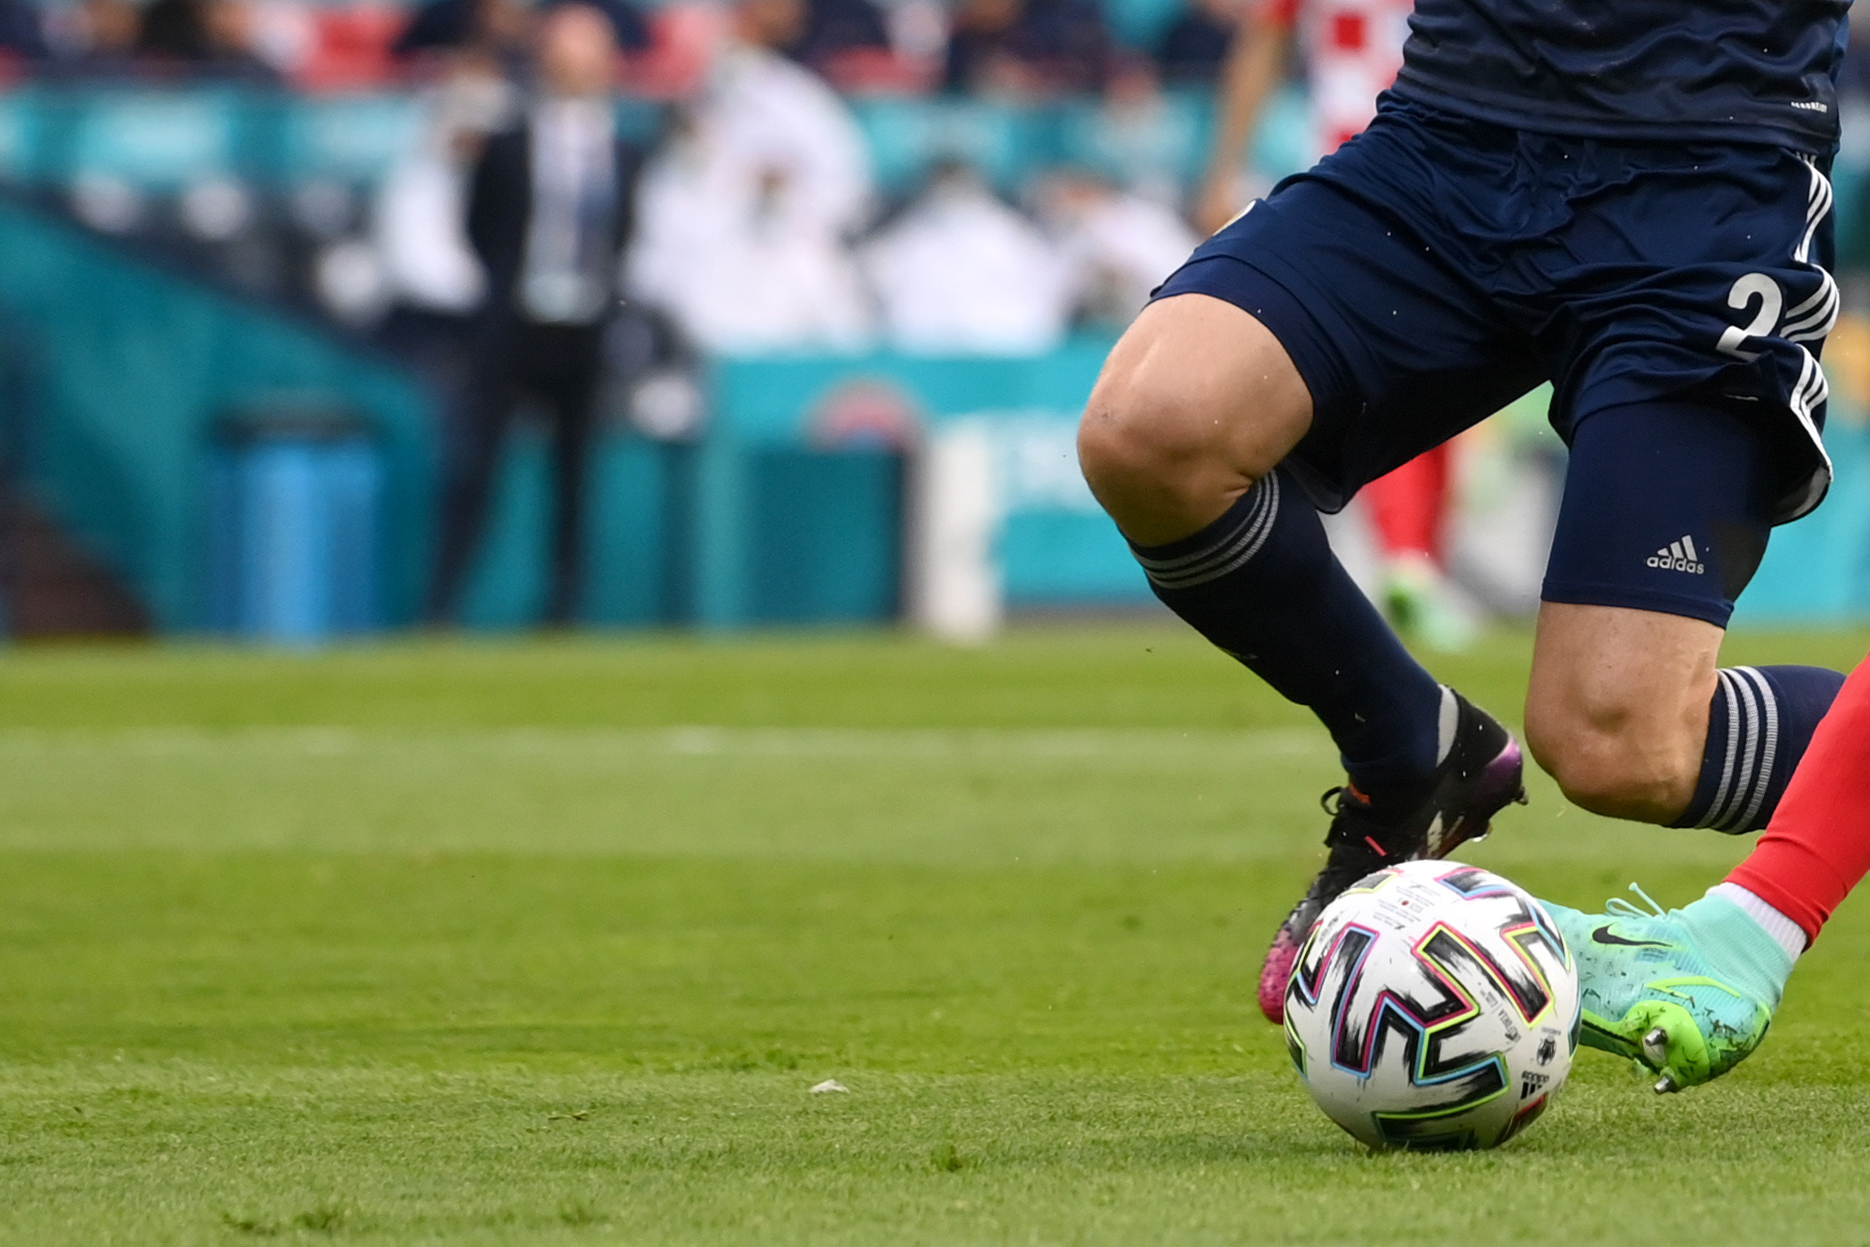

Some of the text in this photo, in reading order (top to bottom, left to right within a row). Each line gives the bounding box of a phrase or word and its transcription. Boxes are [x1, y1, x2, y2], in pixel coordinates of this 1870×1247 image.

[1716, 272, 1783, 360] 2
[1646, 555, 1705, 575] adidas
[1521, 1070, 1550, 1083] adidas
